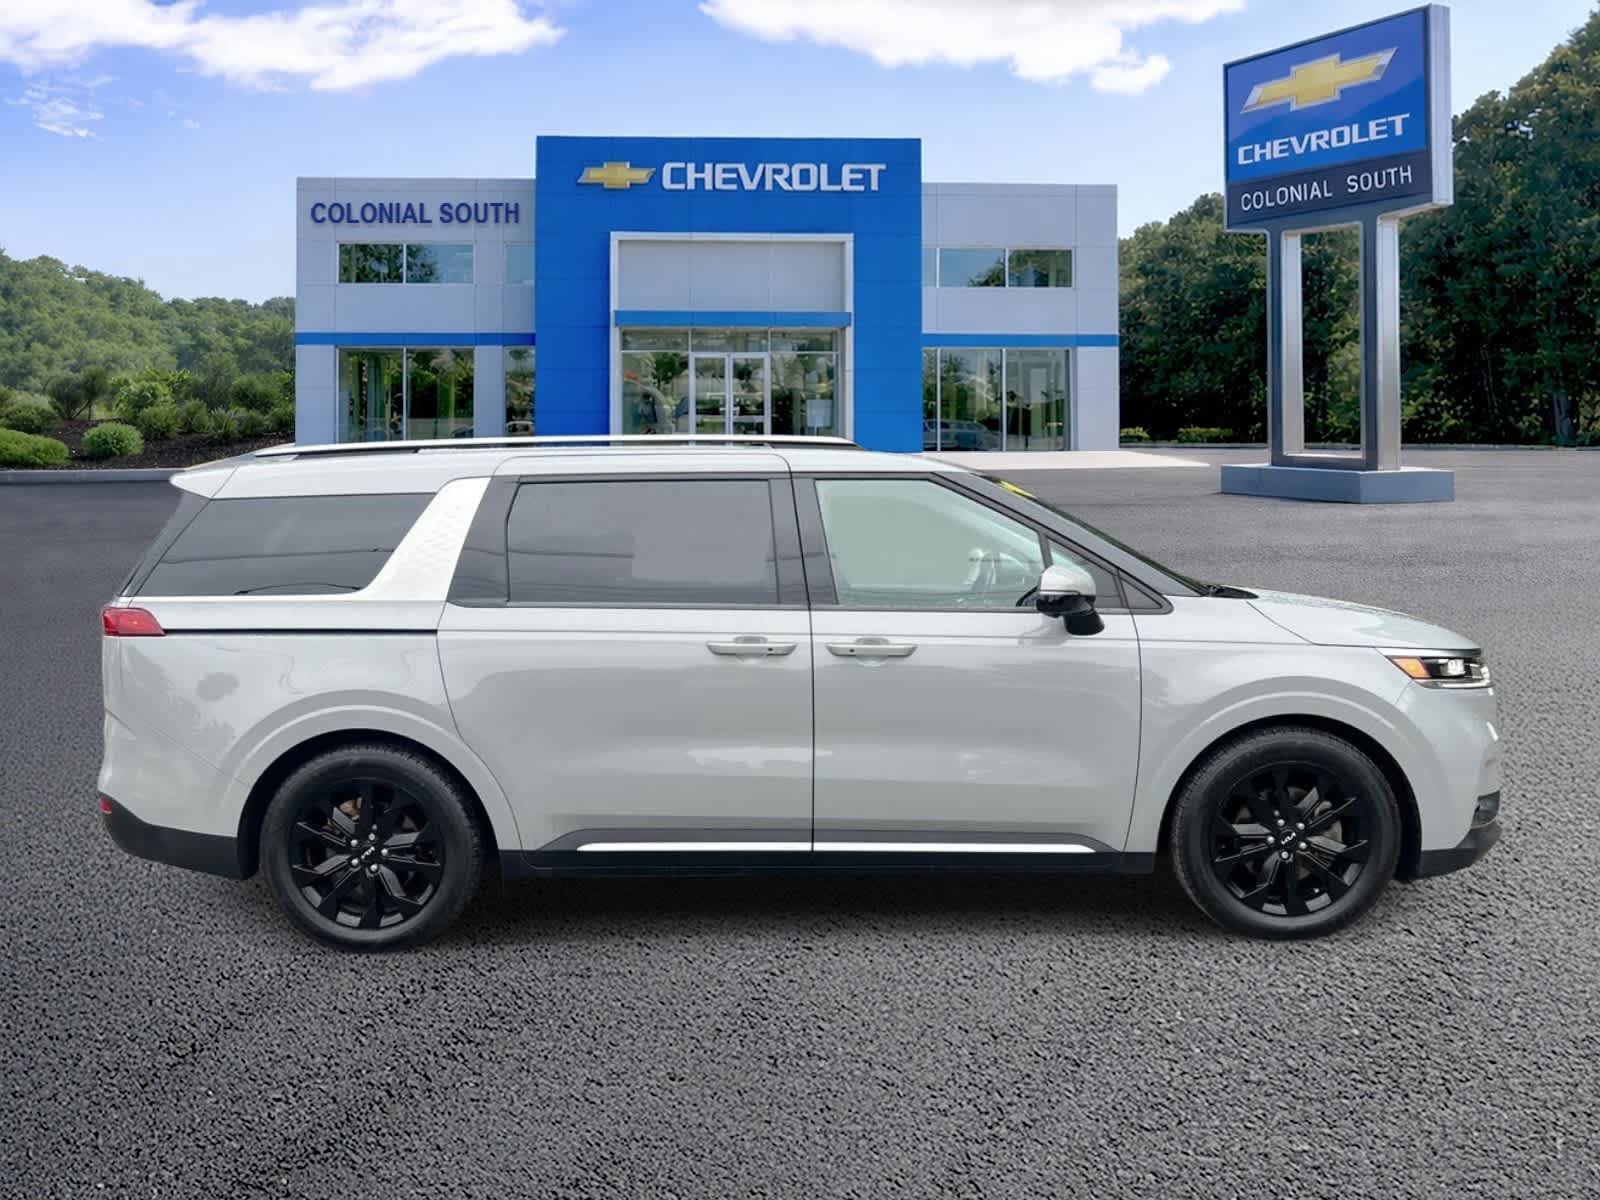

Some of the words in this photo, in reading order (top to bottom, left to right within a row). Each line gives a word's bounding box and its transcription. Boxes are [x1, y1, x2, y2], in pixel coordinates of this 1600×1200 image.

[1238, 113, 1410, 165] CHEVROLET
[661, 161, 887, 192] CHEVROLET
[1240, 180, 1333, 211] COLONIAL
[1346, 165, 1412, 193] SOUTH
[310, 202, 433, 225] COLONIAL
[439, 202, 520, 225] SOUTH
